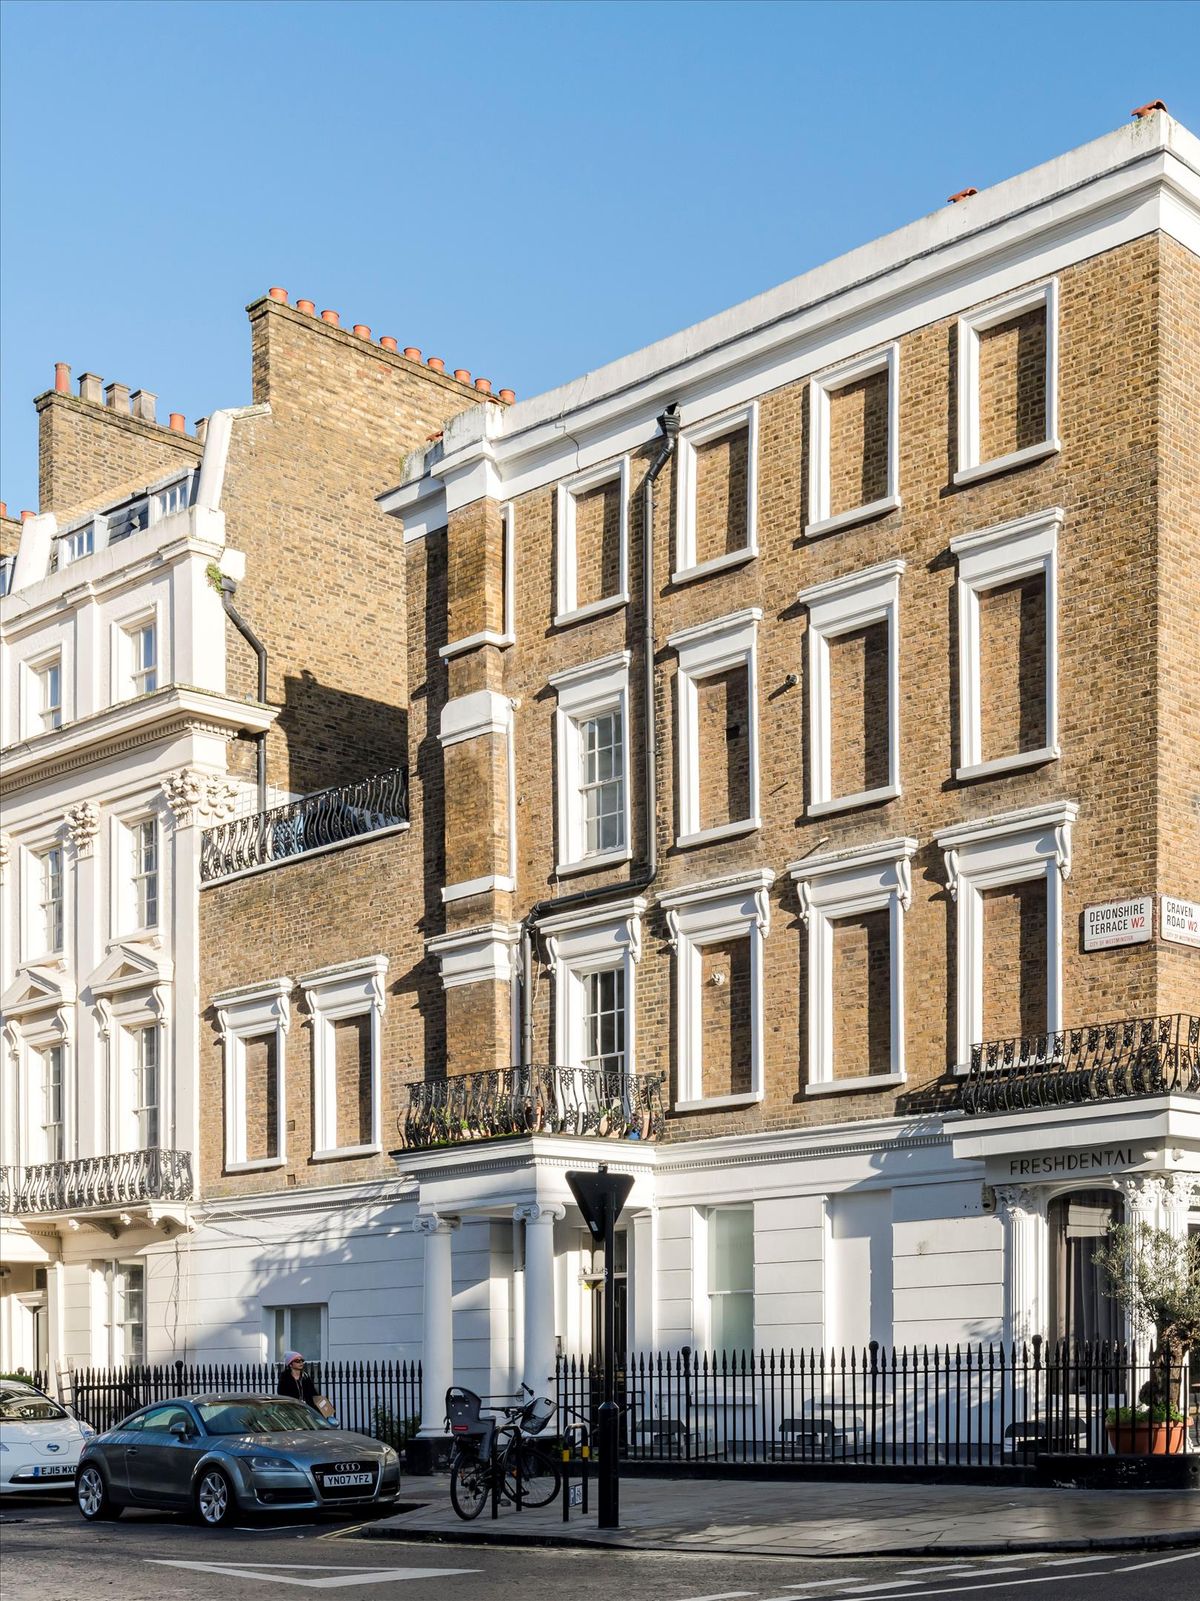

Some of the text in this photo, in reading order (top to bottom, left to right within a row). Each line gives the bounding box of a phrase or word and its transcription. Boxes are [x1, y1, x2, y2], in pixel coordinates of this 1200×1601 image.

[1089, 903, 1145, 923] DEVONSHIRE
[1166, 901, 1193, 918] CRAVEN
[1090, 916, 1145, 935] TERRACE W2
[1166, 914, 1198, 933] ROAD W2
[1010, 1148, 1137, 1176] FRESHDENTAL
[41, 1466, 60, 1475] EJ15
[327, 1474, 370, 1486] YN07 YFZ
